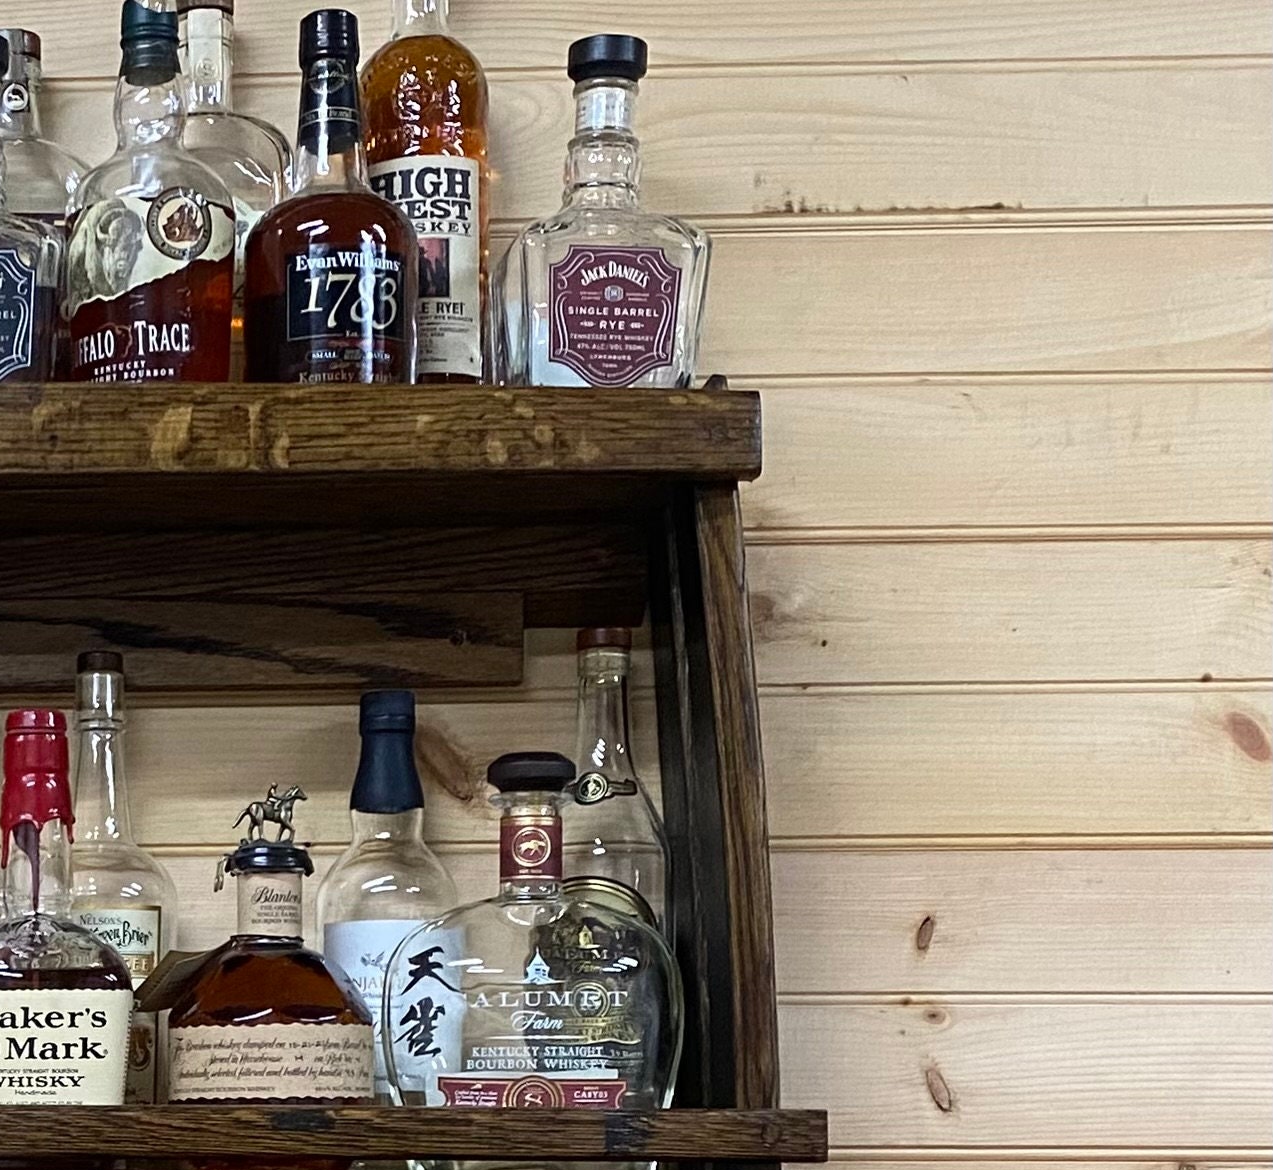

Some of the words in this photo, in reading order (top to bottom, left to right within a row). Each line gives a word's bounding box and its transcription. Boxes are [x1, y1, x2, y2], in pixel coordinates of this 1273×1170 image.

[370, 166, 472, 200] HIGH
[418, 222, 472, 237] SKEY
[295, 254, 338, 272] Evan
[580, 265, 608, 287] JACK
[567, 305, 609, 316] SINGLE
[614, 306, 659, 317] BARREL
[599, 320, 626, 330] RYE
[133, 320, 191, 356] TRACE
[510, 1009, 564, 1032] Farm
[4, 1036, 106, 1061] Mark
[471, 1046, 539, 1058] KENTUCKY
[543, 1046, 605, 1057] STRAIGHT
[466, 1058, 539, 1070] BOURBON
[544, 1058, 609, 1070] WHISKEY
